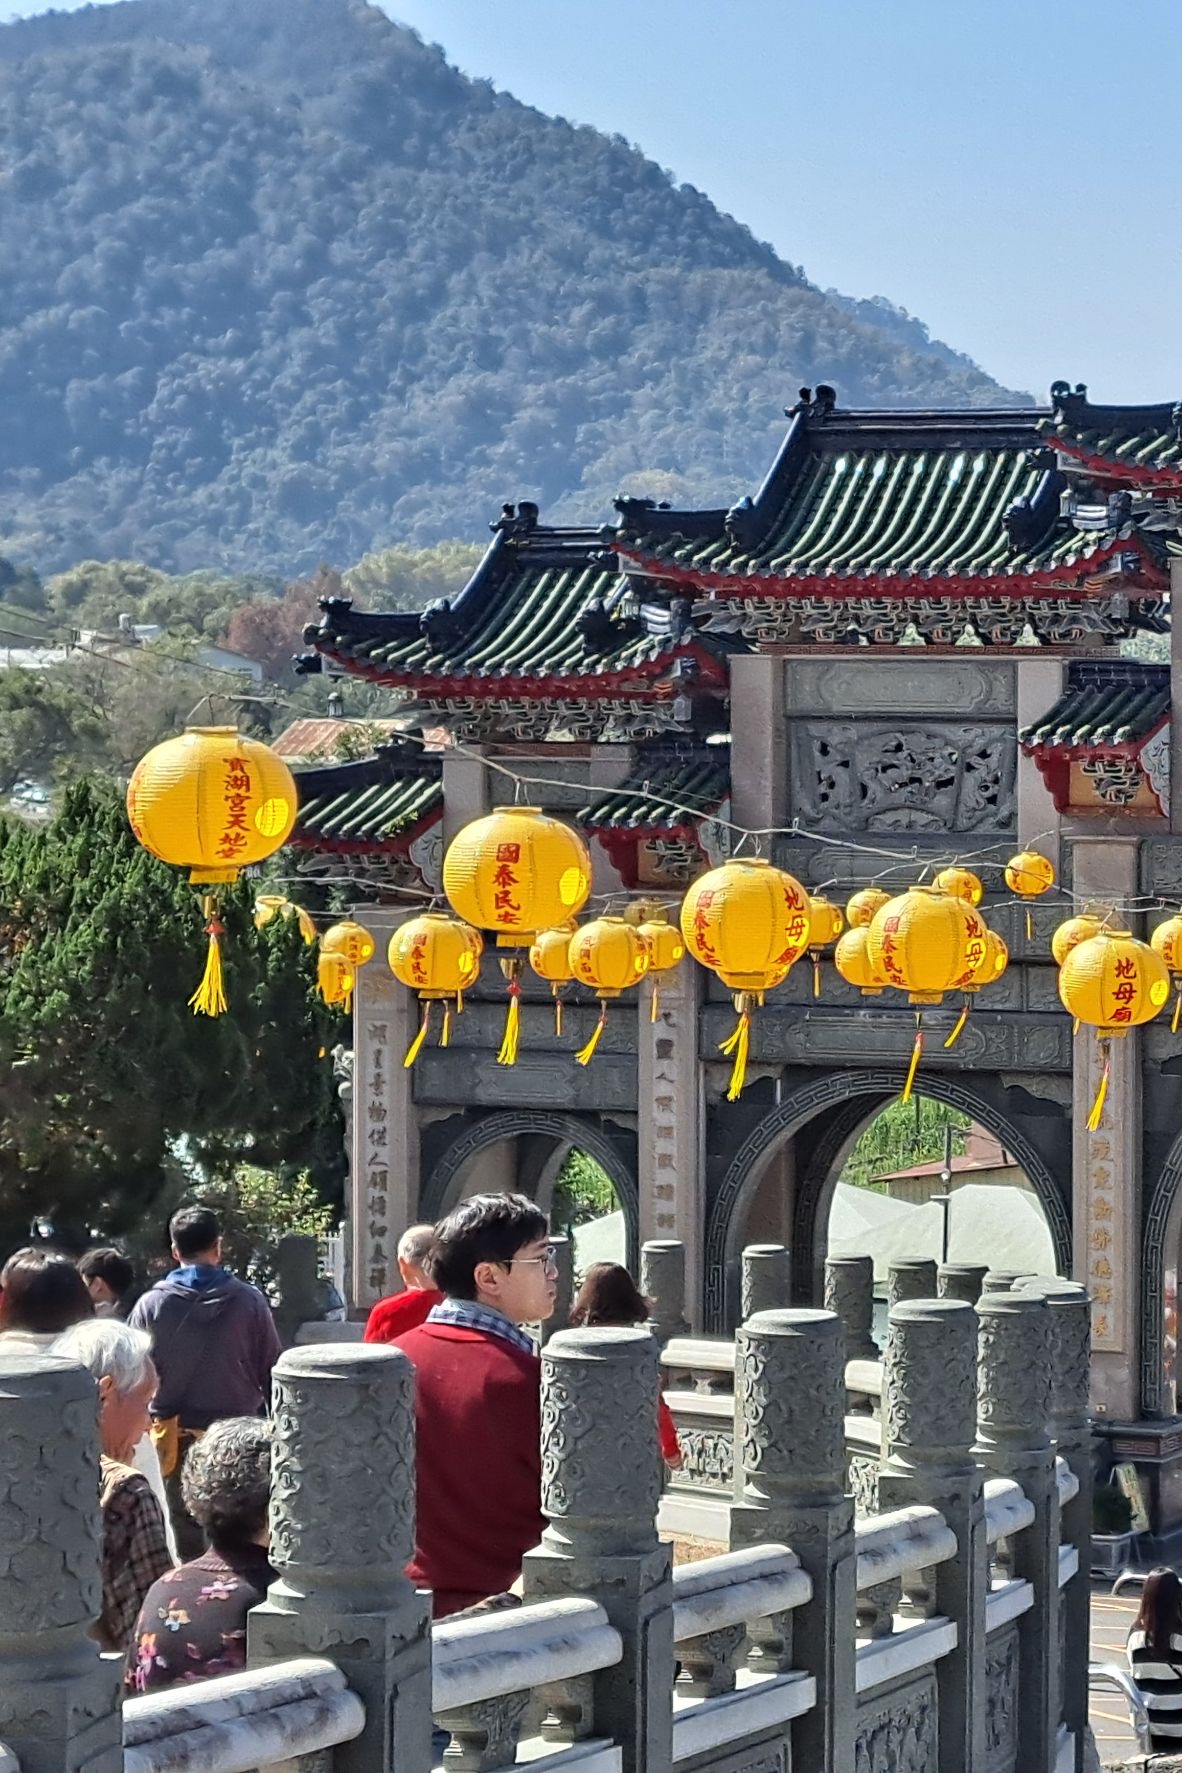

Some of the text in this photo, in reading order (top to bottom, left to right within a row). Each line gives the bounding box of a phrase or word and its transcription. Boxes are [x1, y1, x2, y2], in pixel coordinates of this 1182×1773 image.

[492, 843, 522, 925] 國泰民安
[772, 886, 807, 965] 地母廟
[1109, 957, 1138, 1023] 地母廟
